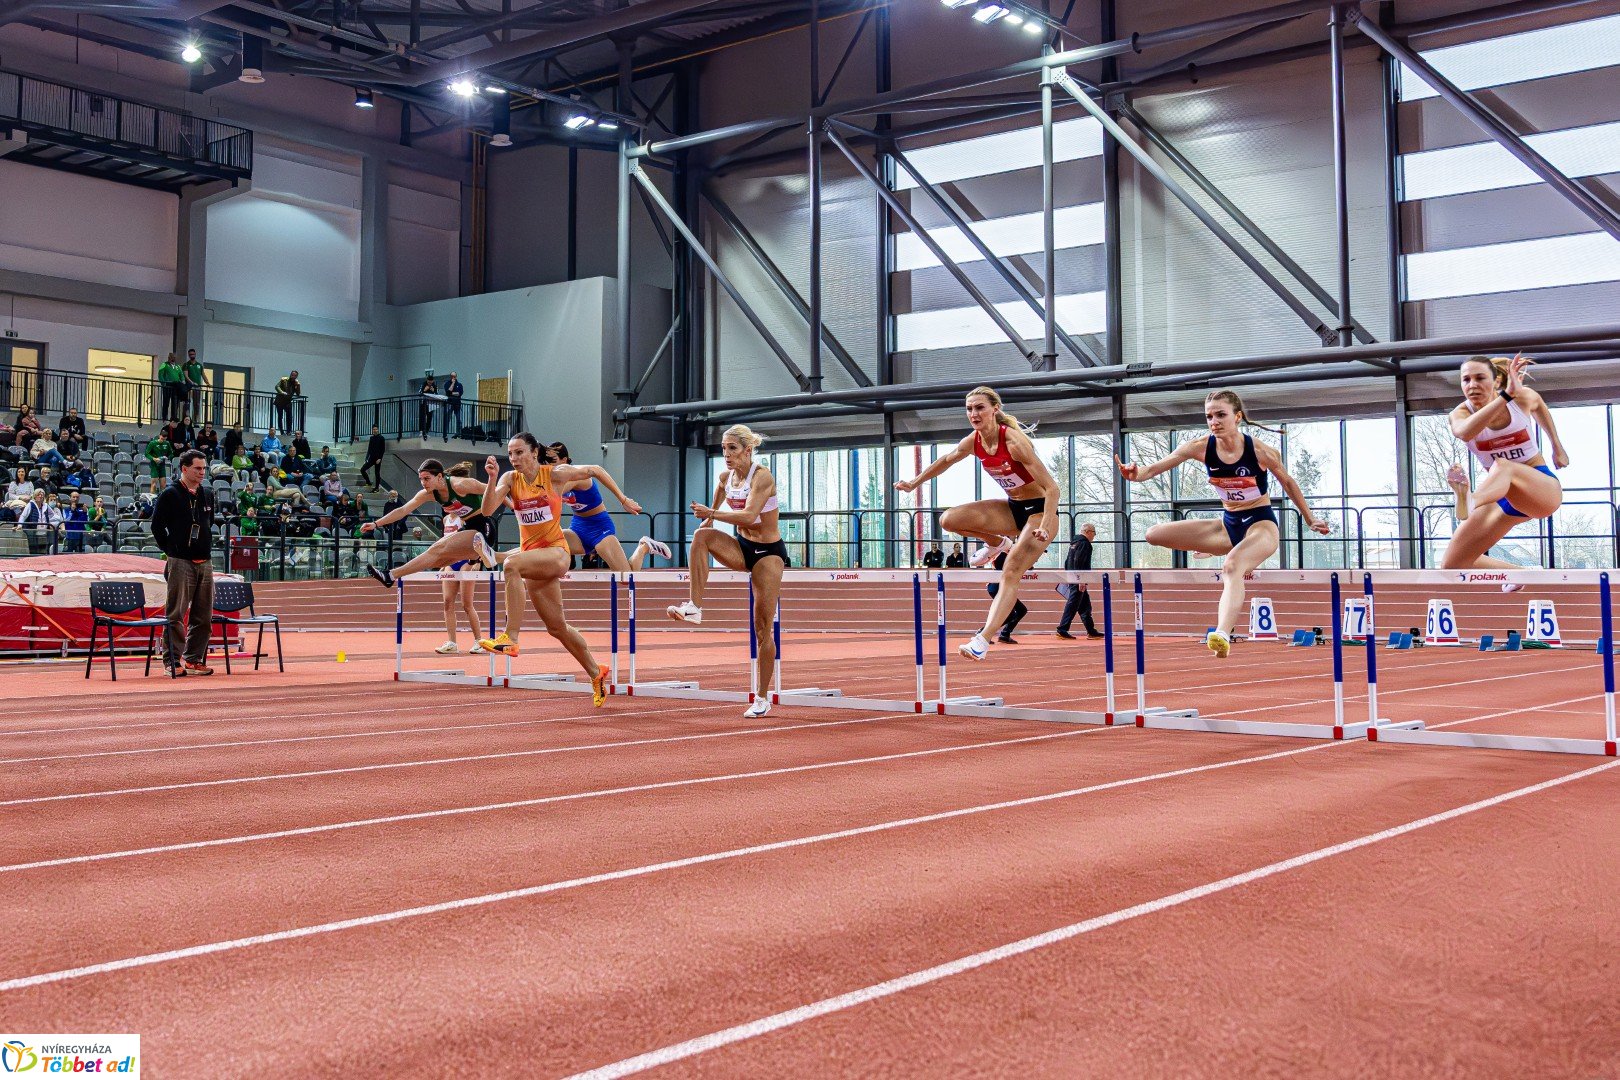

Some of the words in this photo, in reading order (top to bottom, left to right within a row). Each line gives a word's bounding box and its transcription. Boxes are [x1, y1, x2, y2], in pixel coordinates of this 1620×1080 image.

[520, 509, 546, 524] KOZÁK
[1470, 573, 1507, 582] polanik
[1258, 605, 1272, 631] 8
[1353, 606, 1366, 633] 7
[1428, 607, 1435, 635] 6
[1438, 607, 1453, 635] 6
[1528, 608, 1535, 637] 5
[1540, 608, 1555, 637] 5
